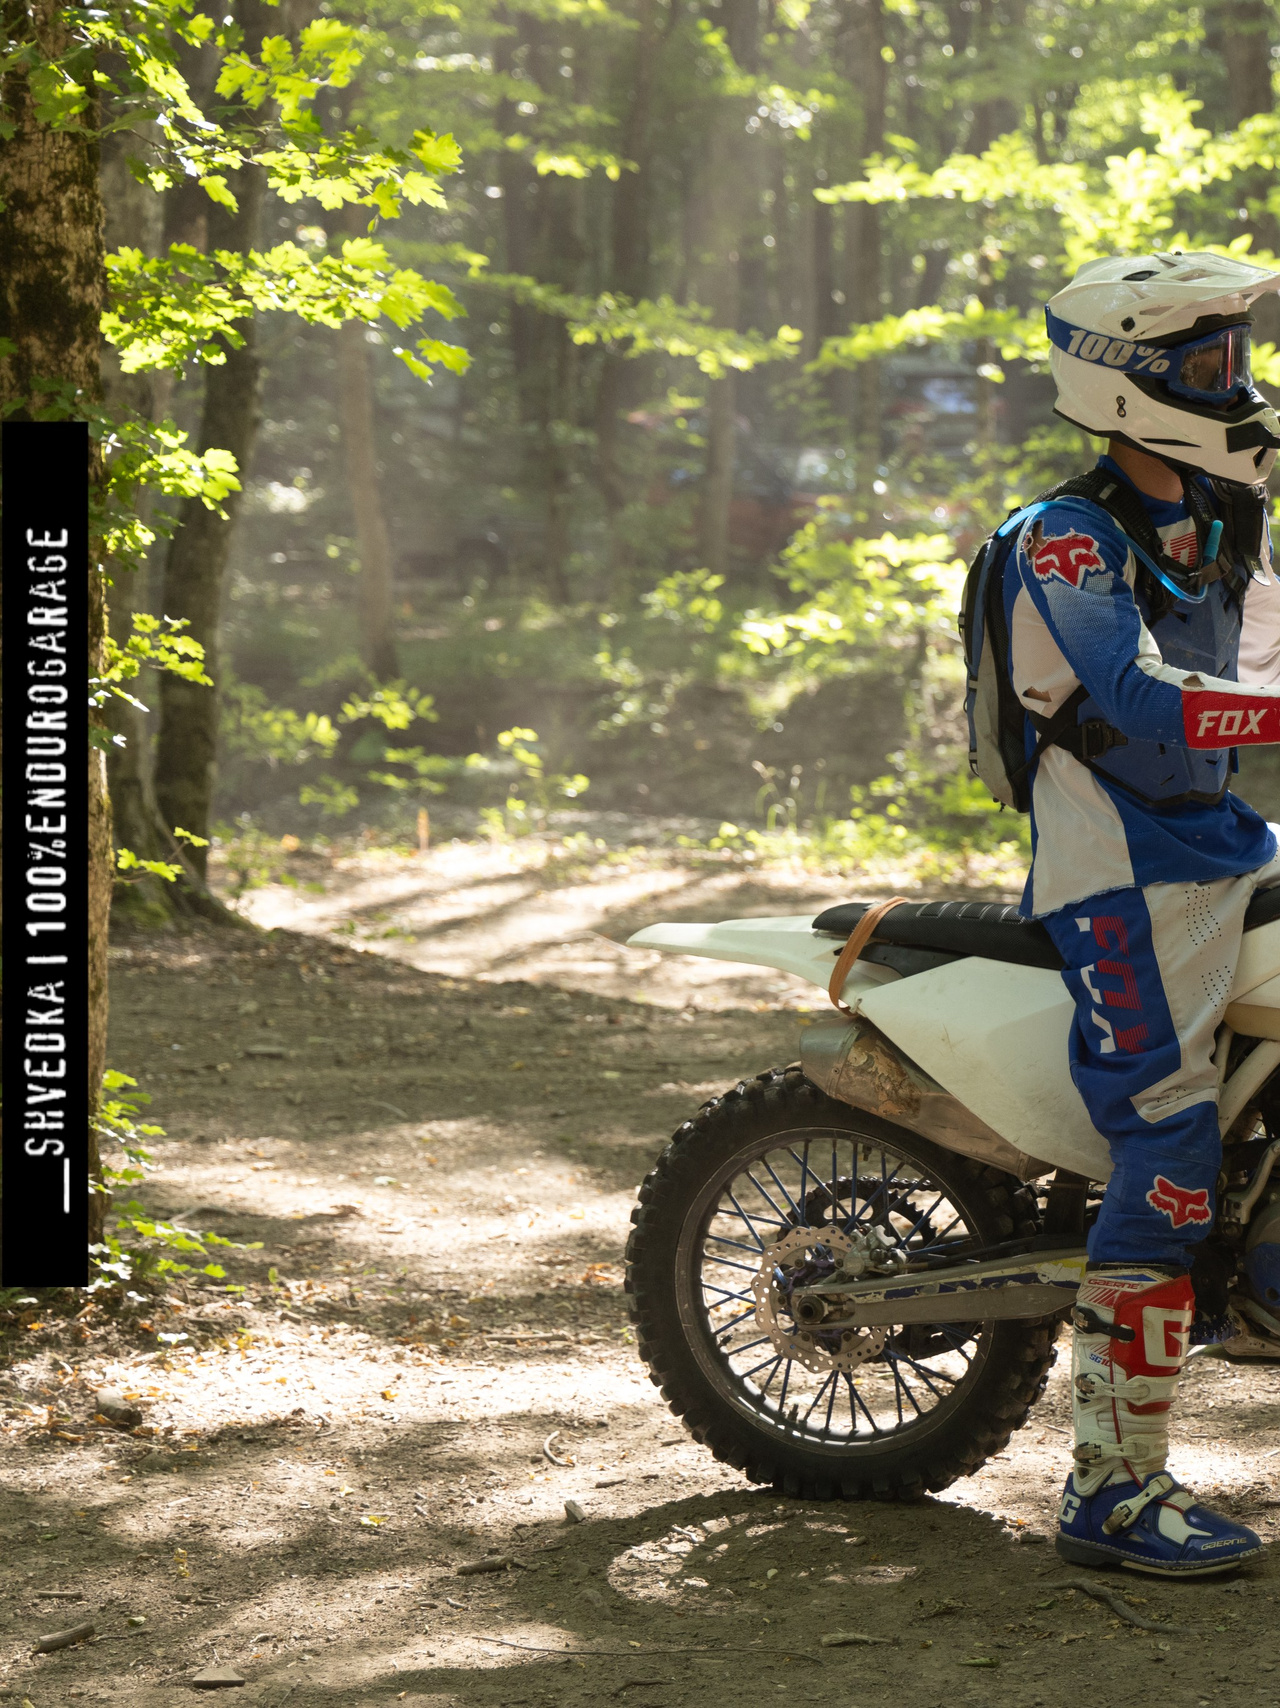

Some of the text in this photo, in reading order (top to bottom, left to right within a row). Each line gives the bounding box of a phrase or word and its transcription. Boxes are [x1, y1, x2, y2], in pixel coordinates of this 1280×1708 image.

[1067, 329, 1171, 373] 100%
[1197, 708, 1268, 737] FOX
[1142, 1305, 1192, 1367] G
[1201, 1537, 1248, 1550] GAERNE
